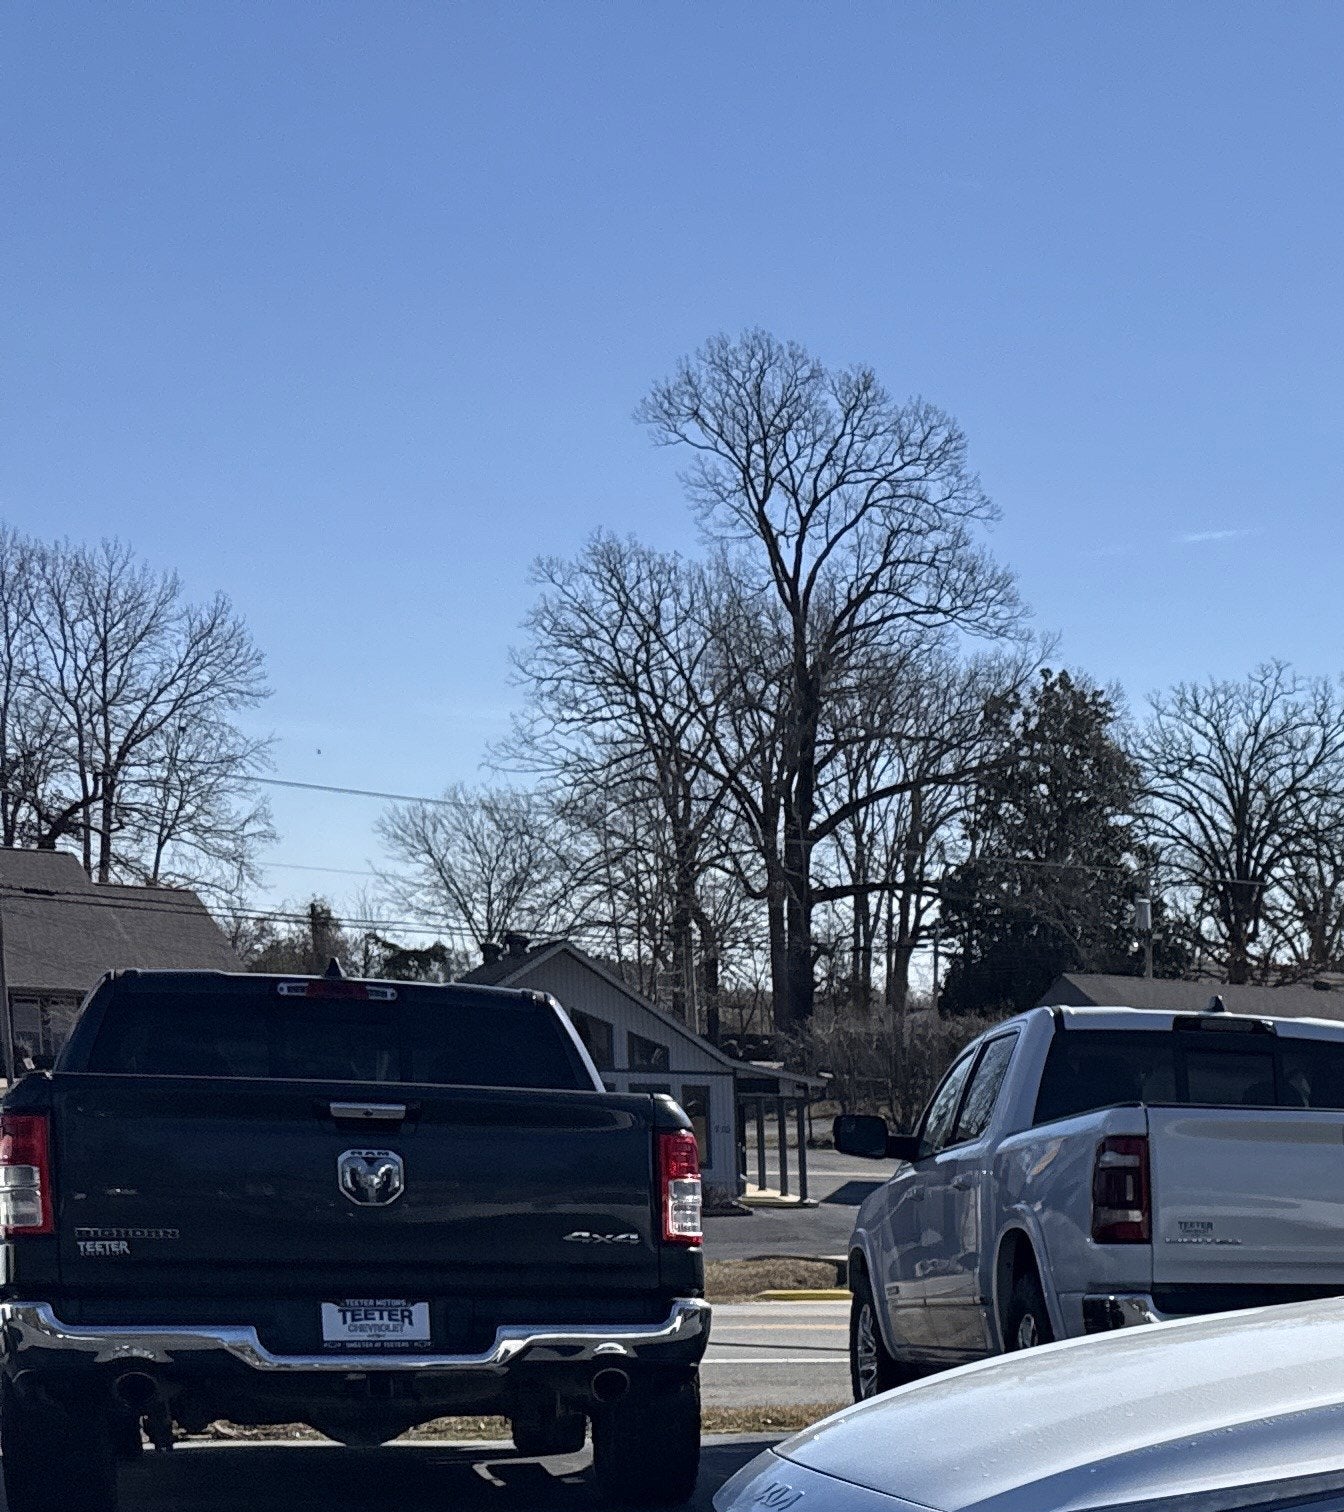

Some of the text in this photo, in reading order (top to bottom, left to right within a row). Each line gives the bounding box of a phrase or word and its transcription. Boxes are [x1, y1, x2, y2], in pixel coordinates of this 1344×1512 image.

[77, 1241, 131, 1254] TEETER
[338, 1308, 414, 1327] TEETER
[347, 1323, 404, 1333] CHEVROLET
